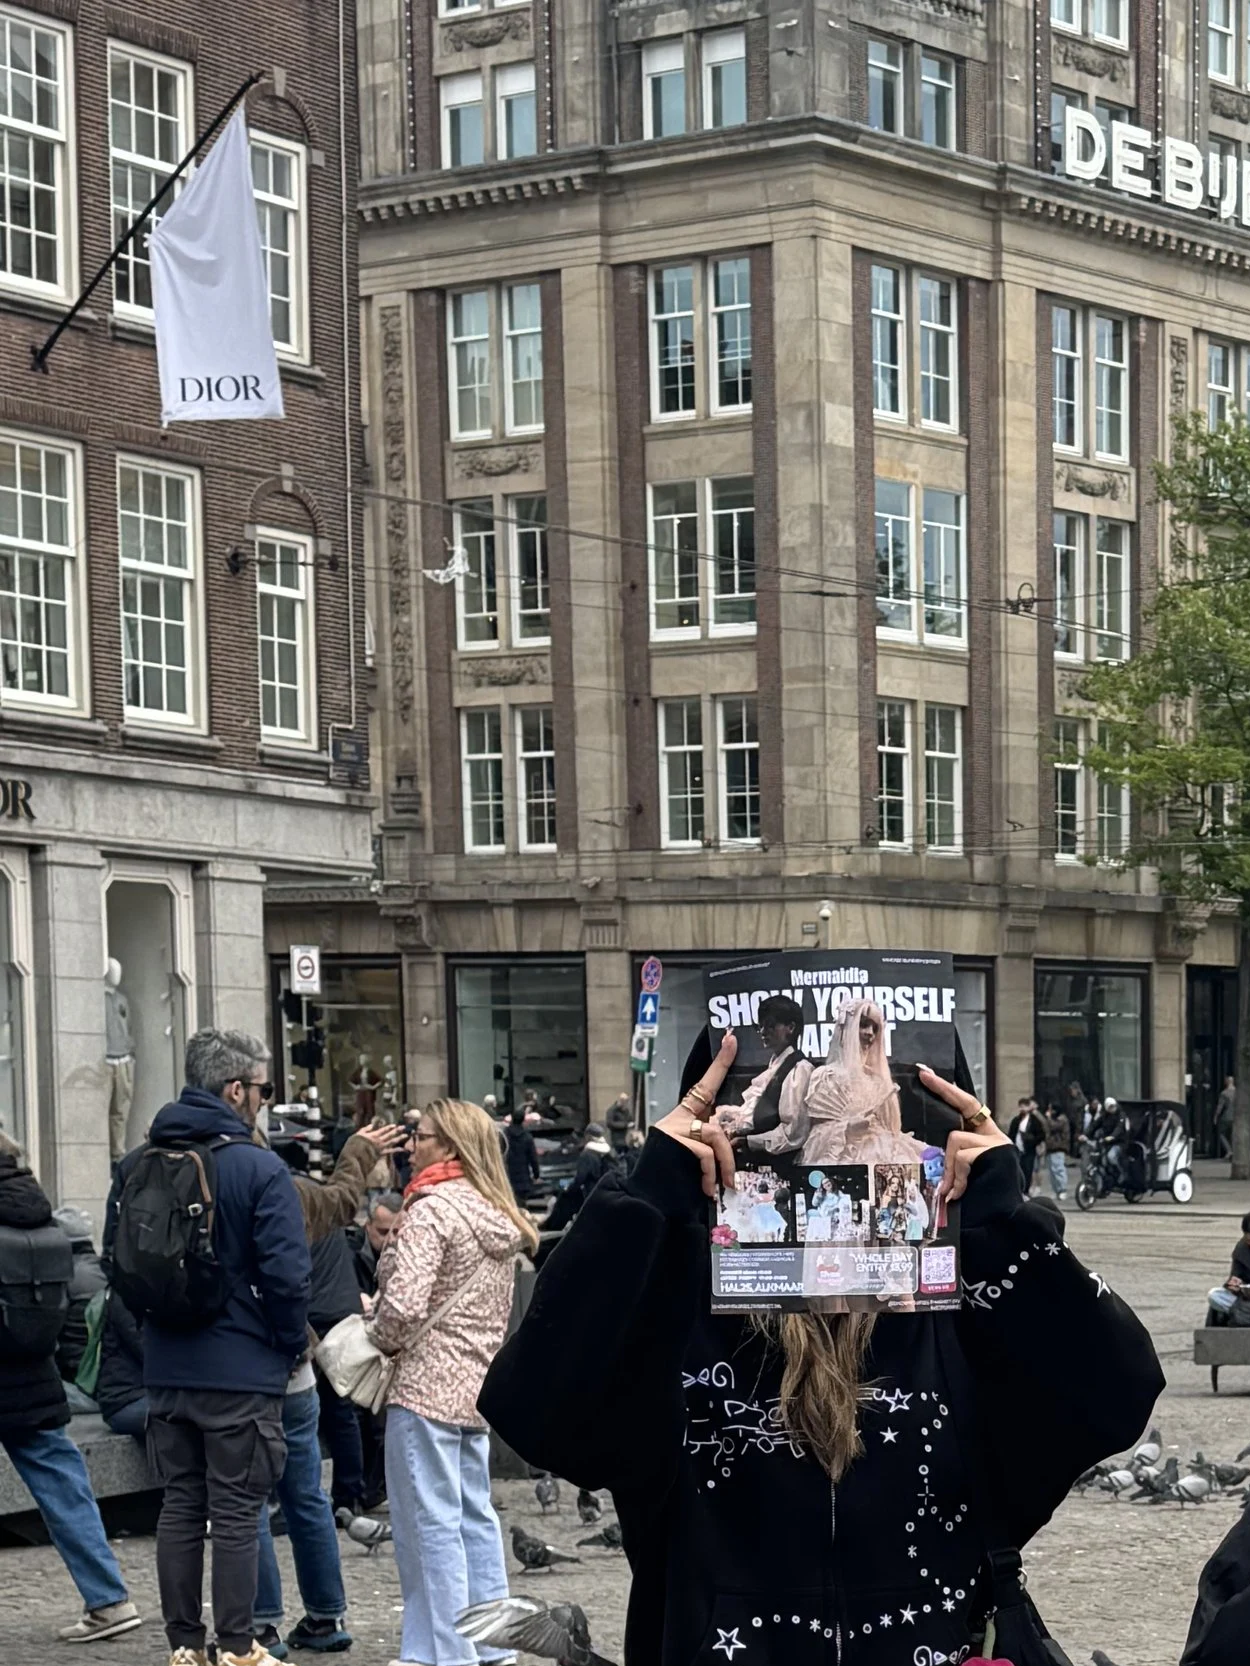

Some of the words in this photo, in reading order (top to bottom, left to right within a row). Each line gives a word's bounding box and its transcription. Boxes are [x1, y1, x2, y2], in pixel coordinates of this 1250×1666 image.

[1065, 104, 1152, 198] DE
[179, 375, 265, 402] DIOR
[892, 1252, 913, 1262] DAY
[856, 1263, 888, 1272] ENTRY
